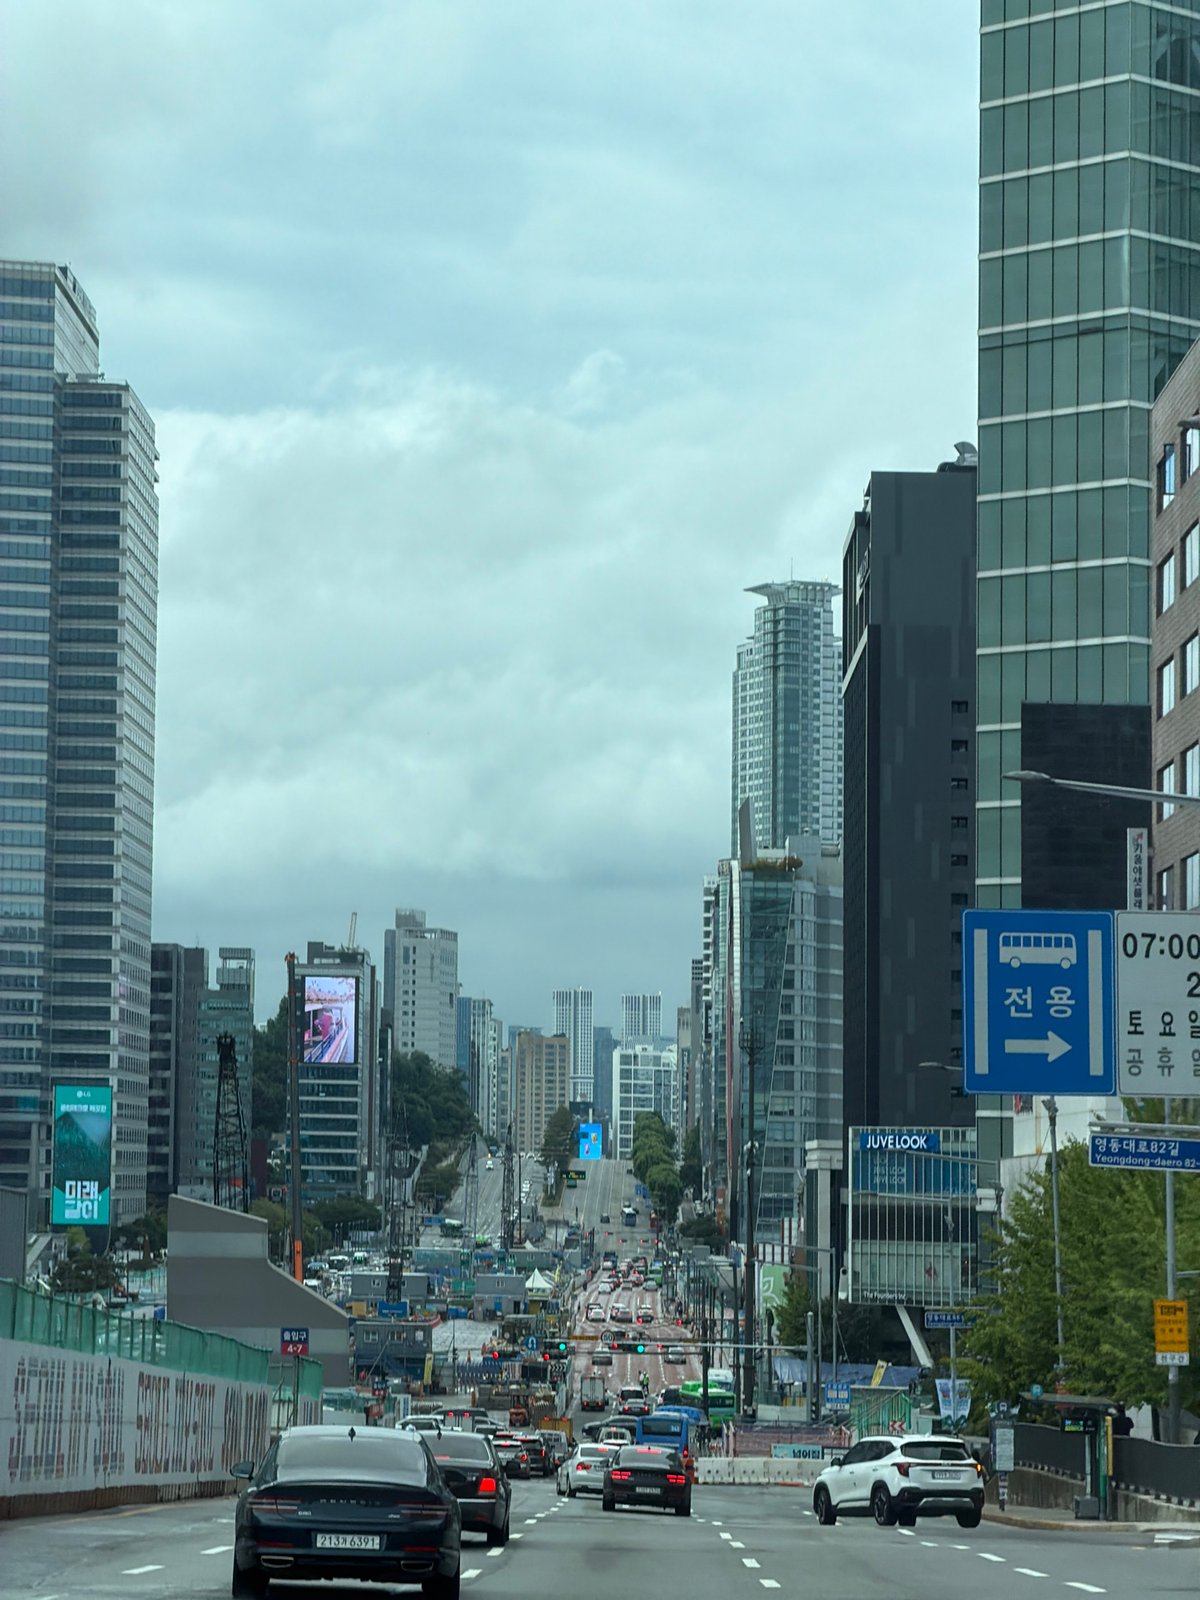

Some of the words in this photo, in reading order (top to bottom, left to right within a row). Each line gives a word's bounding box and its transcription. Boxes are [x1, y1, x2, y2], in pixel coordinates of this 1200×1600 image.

[1122, 932, 1200, 960] 07:00
[1095, 1137, 1180, 1157] 영동대로82길
[1095, 1153, 1183, 1167] Yeongdong-daero
